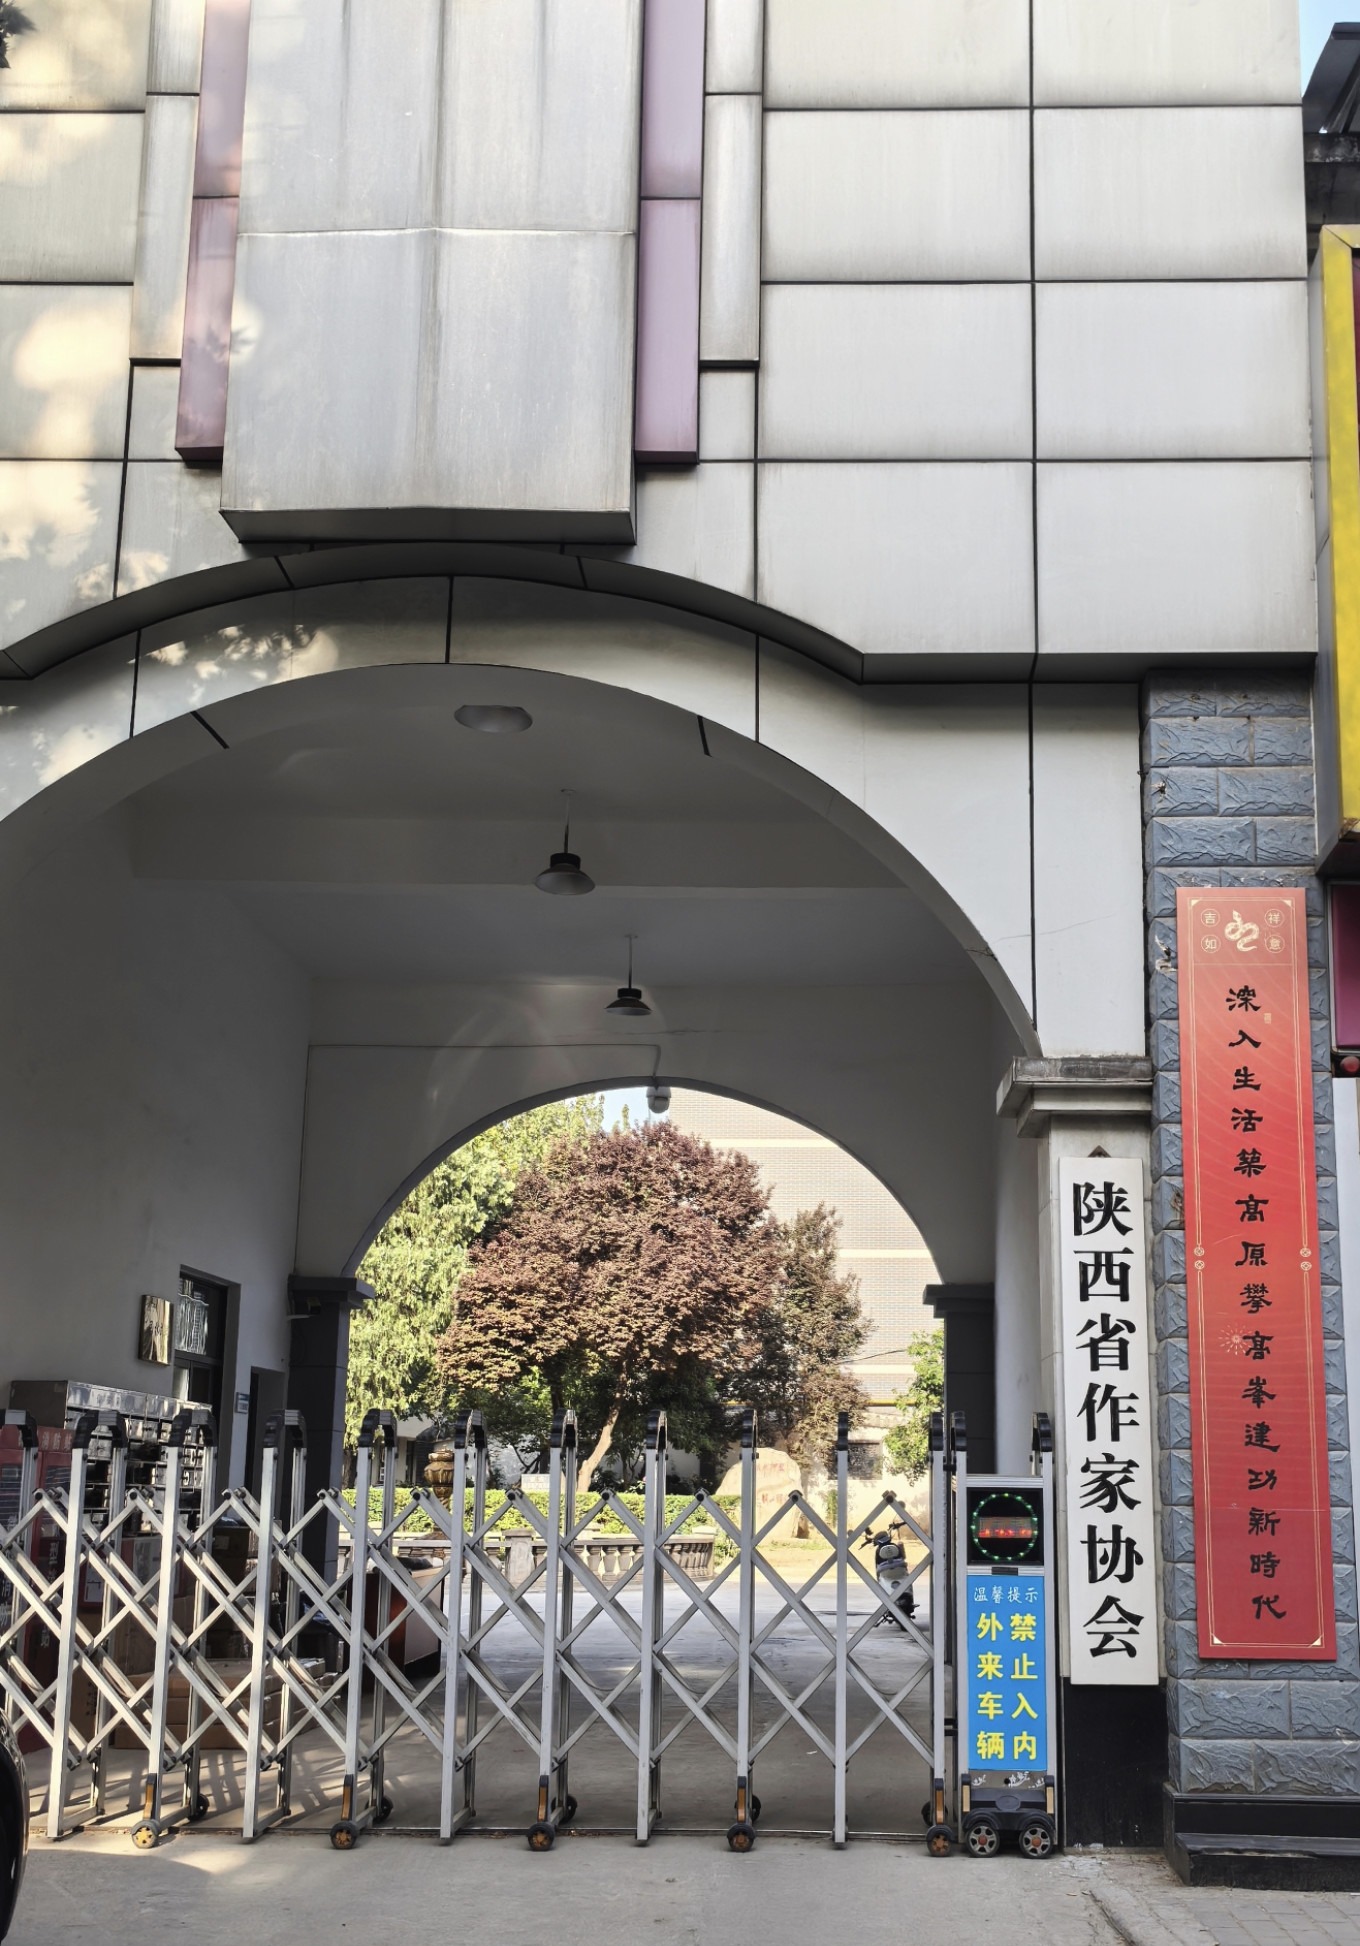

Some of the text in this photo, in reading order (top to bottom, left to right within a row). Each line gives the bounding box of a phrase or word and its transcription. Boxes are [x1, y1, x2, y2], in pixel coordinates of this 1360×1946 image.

[1072, 1181, 1145, 1659] 陕西省作家协会
[974, 1585, 1039, 1604] 温馨提示
[977, 1613, 1004, 1760] 外来车辆
[1010, 1613, 1038, 1760] 禁止入内
